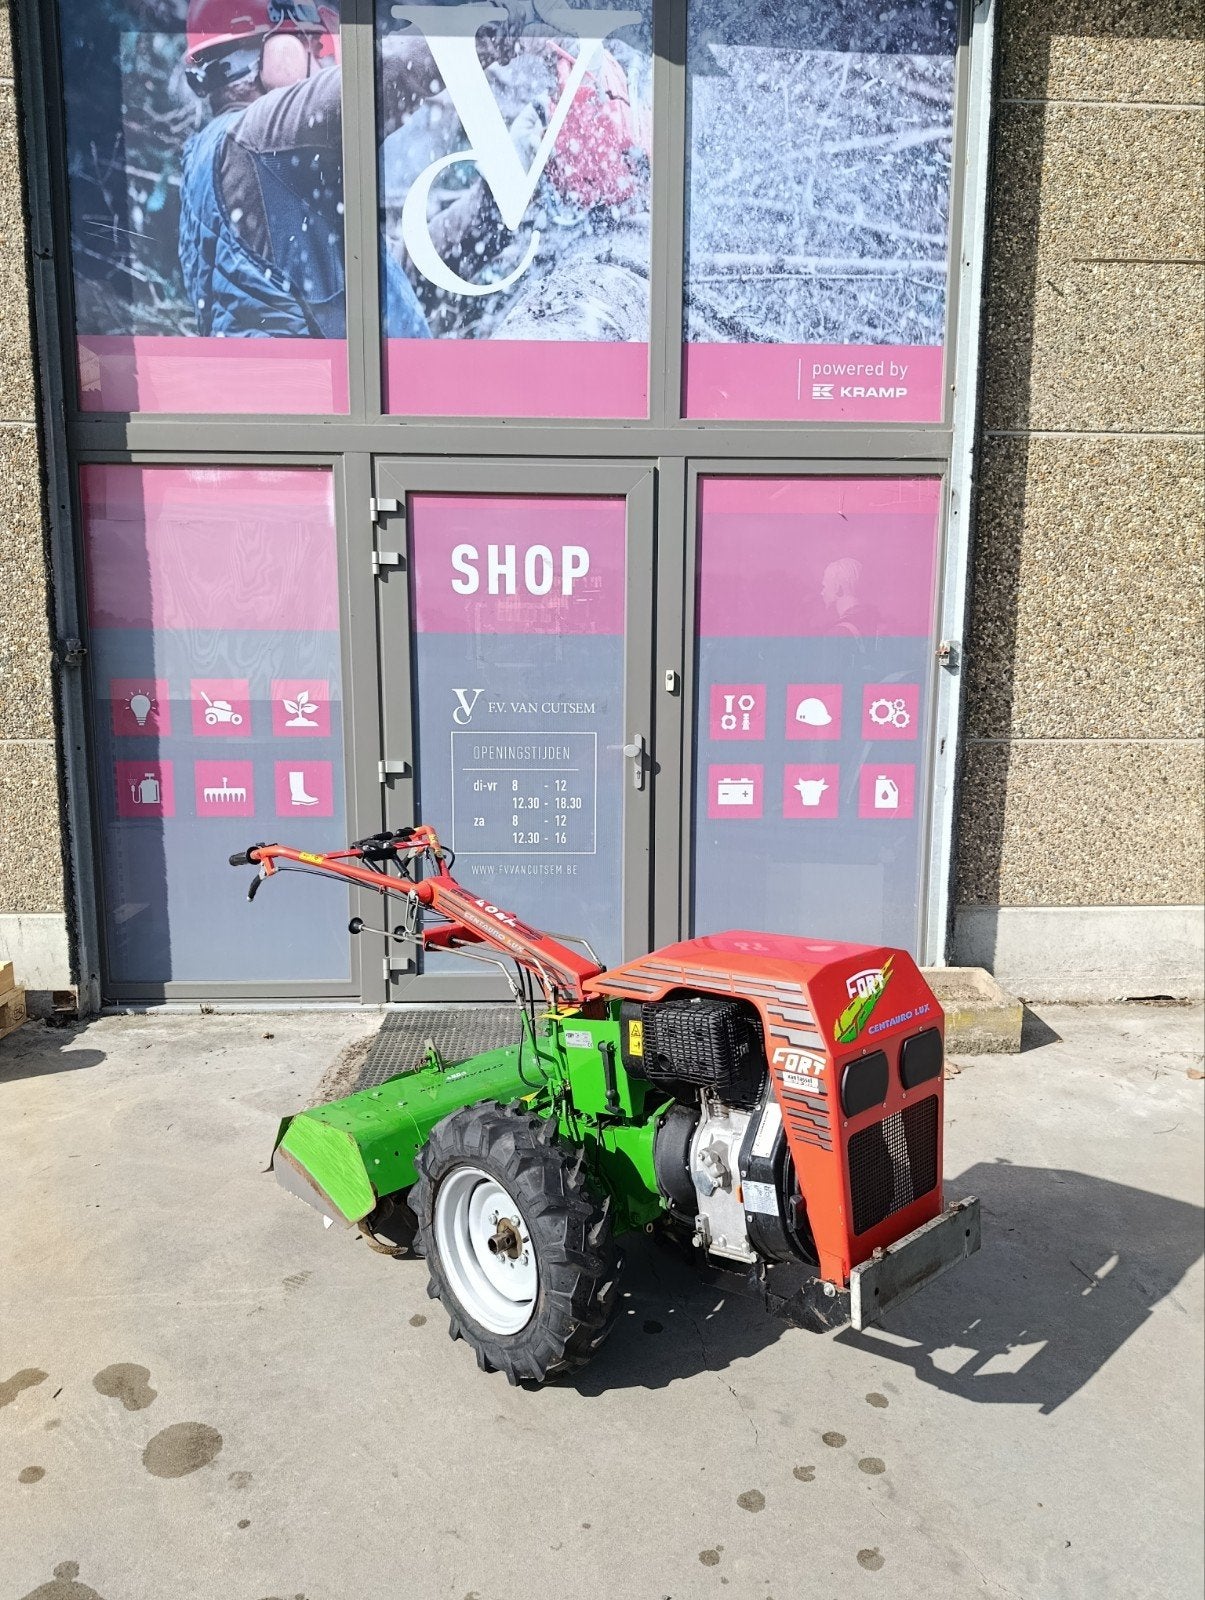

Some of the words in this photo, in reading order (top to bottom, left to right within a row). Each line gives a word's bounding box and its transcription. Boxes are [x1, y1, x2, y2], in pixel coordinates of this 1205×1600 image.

[812, 361, 884, 379] powered
[890, 361, 908, 380] by
[840, 386, 908, 398] KRAMP
[451, 544, 590, 596] SHOP
[510, 703, 538, 713] VAN
[542, 702, 596, 714] CUTSEM
[473, 746, 570, 760] OPENINGSTIJDEN
[474, 780, 498, 791] di-vr
[512, 780, 518, 791] 8
[555, 780, 566, 791] 12
[512, 798, 540, 809] 12.30
[555, 798, 582, 809] 18.30
[474, 818, 484, 826] za
[512, 816, 518, 826] 8
[555, 816, 566, 826] 12
[512, 832, 540, 844] 12.30
[555, 832, 566, 844] 16
[464, 911, 506, 941] CENTAURO
[507, 939, 524, 953] LUX
[846, 968, 885, 998] FORT
[868, 1010, 912, 1035] CENTAURO
[915, 1003, 930, 1016] LUX
[772, 1047, 826, 1076] FORT
